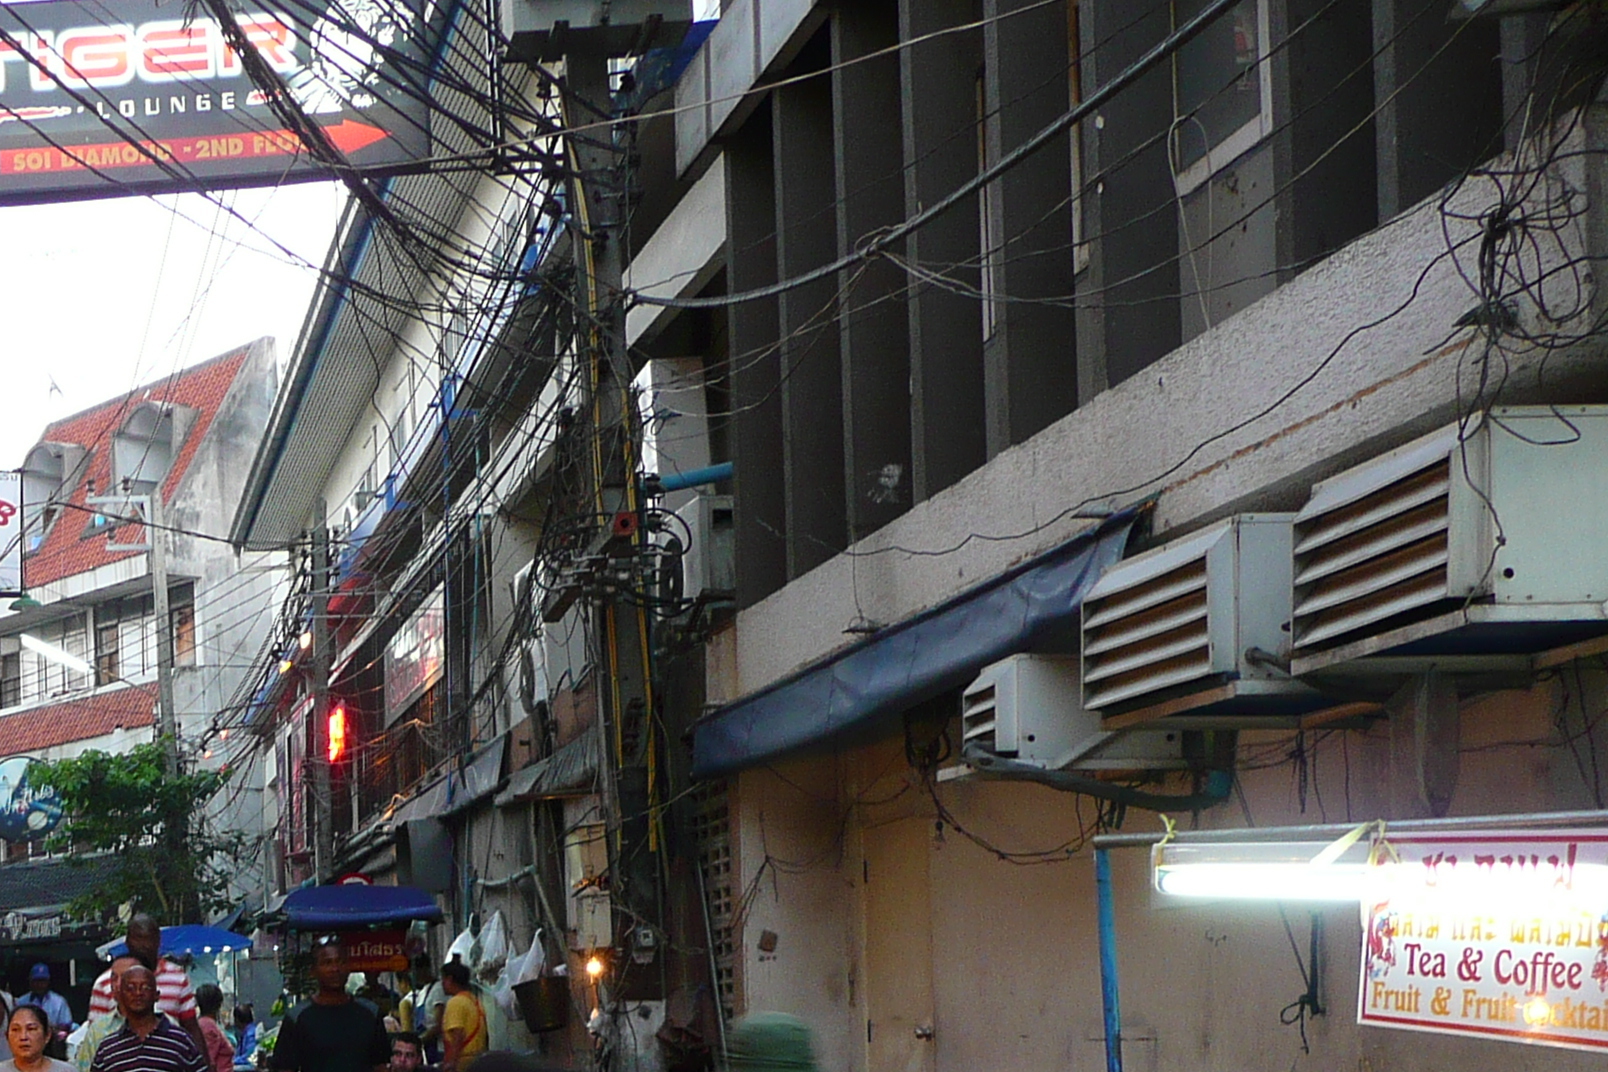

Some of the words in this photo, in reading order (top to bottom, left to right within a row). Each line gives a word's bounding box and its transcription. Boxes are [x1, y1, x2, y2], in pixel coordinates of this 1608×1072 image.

[97, 92, 235, 119] LOUNGE
[13, 152, 52, 171] SOI
[61, 144, 171, 168] DIAMOND
[196, 138, 243, 159] 2ND
[1404, 944, 1447, 977] Tea
[1457, 947, 1484, 983] &
[1494, 950, 1583, 997] Coffee
[1372, 981, 1422, 1014] Fruit
[1430, 987, 1452, 1016] &
[1461, 988, 1517, 1023] Fruit
